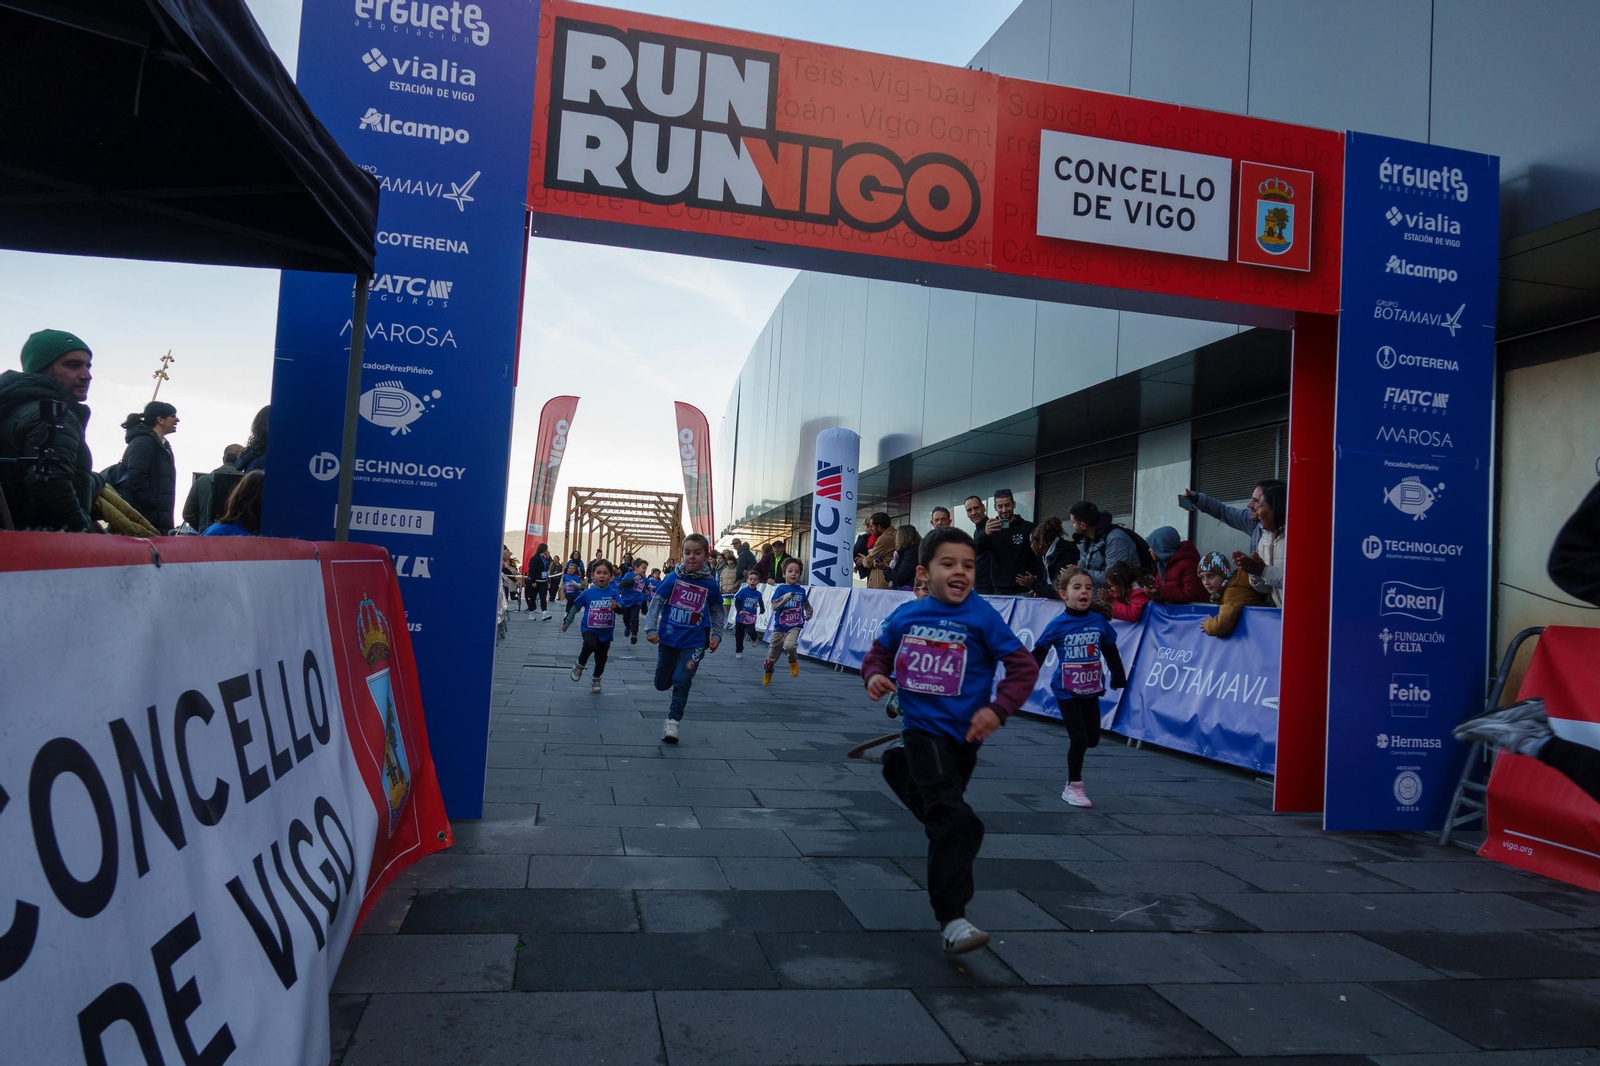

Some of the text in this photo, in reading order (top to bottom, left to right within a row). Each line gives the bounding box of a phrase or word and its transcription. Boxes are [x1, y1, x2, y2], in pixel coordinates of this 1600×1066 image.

[392, 56, 476, 86] vialia
[563, 30, 770, 130] RUN
[389, 81, 475, 102] ESTACIÓN DE VIGO
[359, 107, 470, 145] Alcampo
[1054, 155, 1215, 202] CONCELLO
[1073, 192, 1196, 232] DE VIGO
[1405, 212, 1460, 235] vialia
[376, 231, 469, 254] COTERENA
[1404, 233, 1461, 247] ESTACIÓN DE VIGO
[1385, 255, 1458, 283] Alcampo
[1376, 299, 1398, 308] GRUPO
[1374, 306, 1442, 326] BOTAMAVI
[363, 363, 433, 376] cadosPérezPiñeiro
[1398, 354, 1459, 371] COTERENA
[1384, 387, 1432, 408] FIATC
[1376, 426, 1453, 448] MAROSA
[354, 458, 466, 480] ECHNOLOGY
[842, 466, 855, 577] GUROS
[811, 503, 840, 587] ATC
[1384, 540, 1463, 555] TECHNOLOGY
[680, 590, 702, 603] 2011
[1064, 631, 1100, 646] CORRER
[1395, 631, 1445, 643] FUNDACIÓN
[908, 651, 954, 675] 2014
[1157, 646, 1193, 663] GRUPO
[1072, 670, 1099, 684] 2003
[1145, 661, 1267, 705] BOTAMAVI
[1389, 683, 1431, 701] Feito
[1391, 735, 1442, 748] Hermasa
[1502, 839, 1533, 856] vigo.org
[225, 795, 355, 991] VIGO
